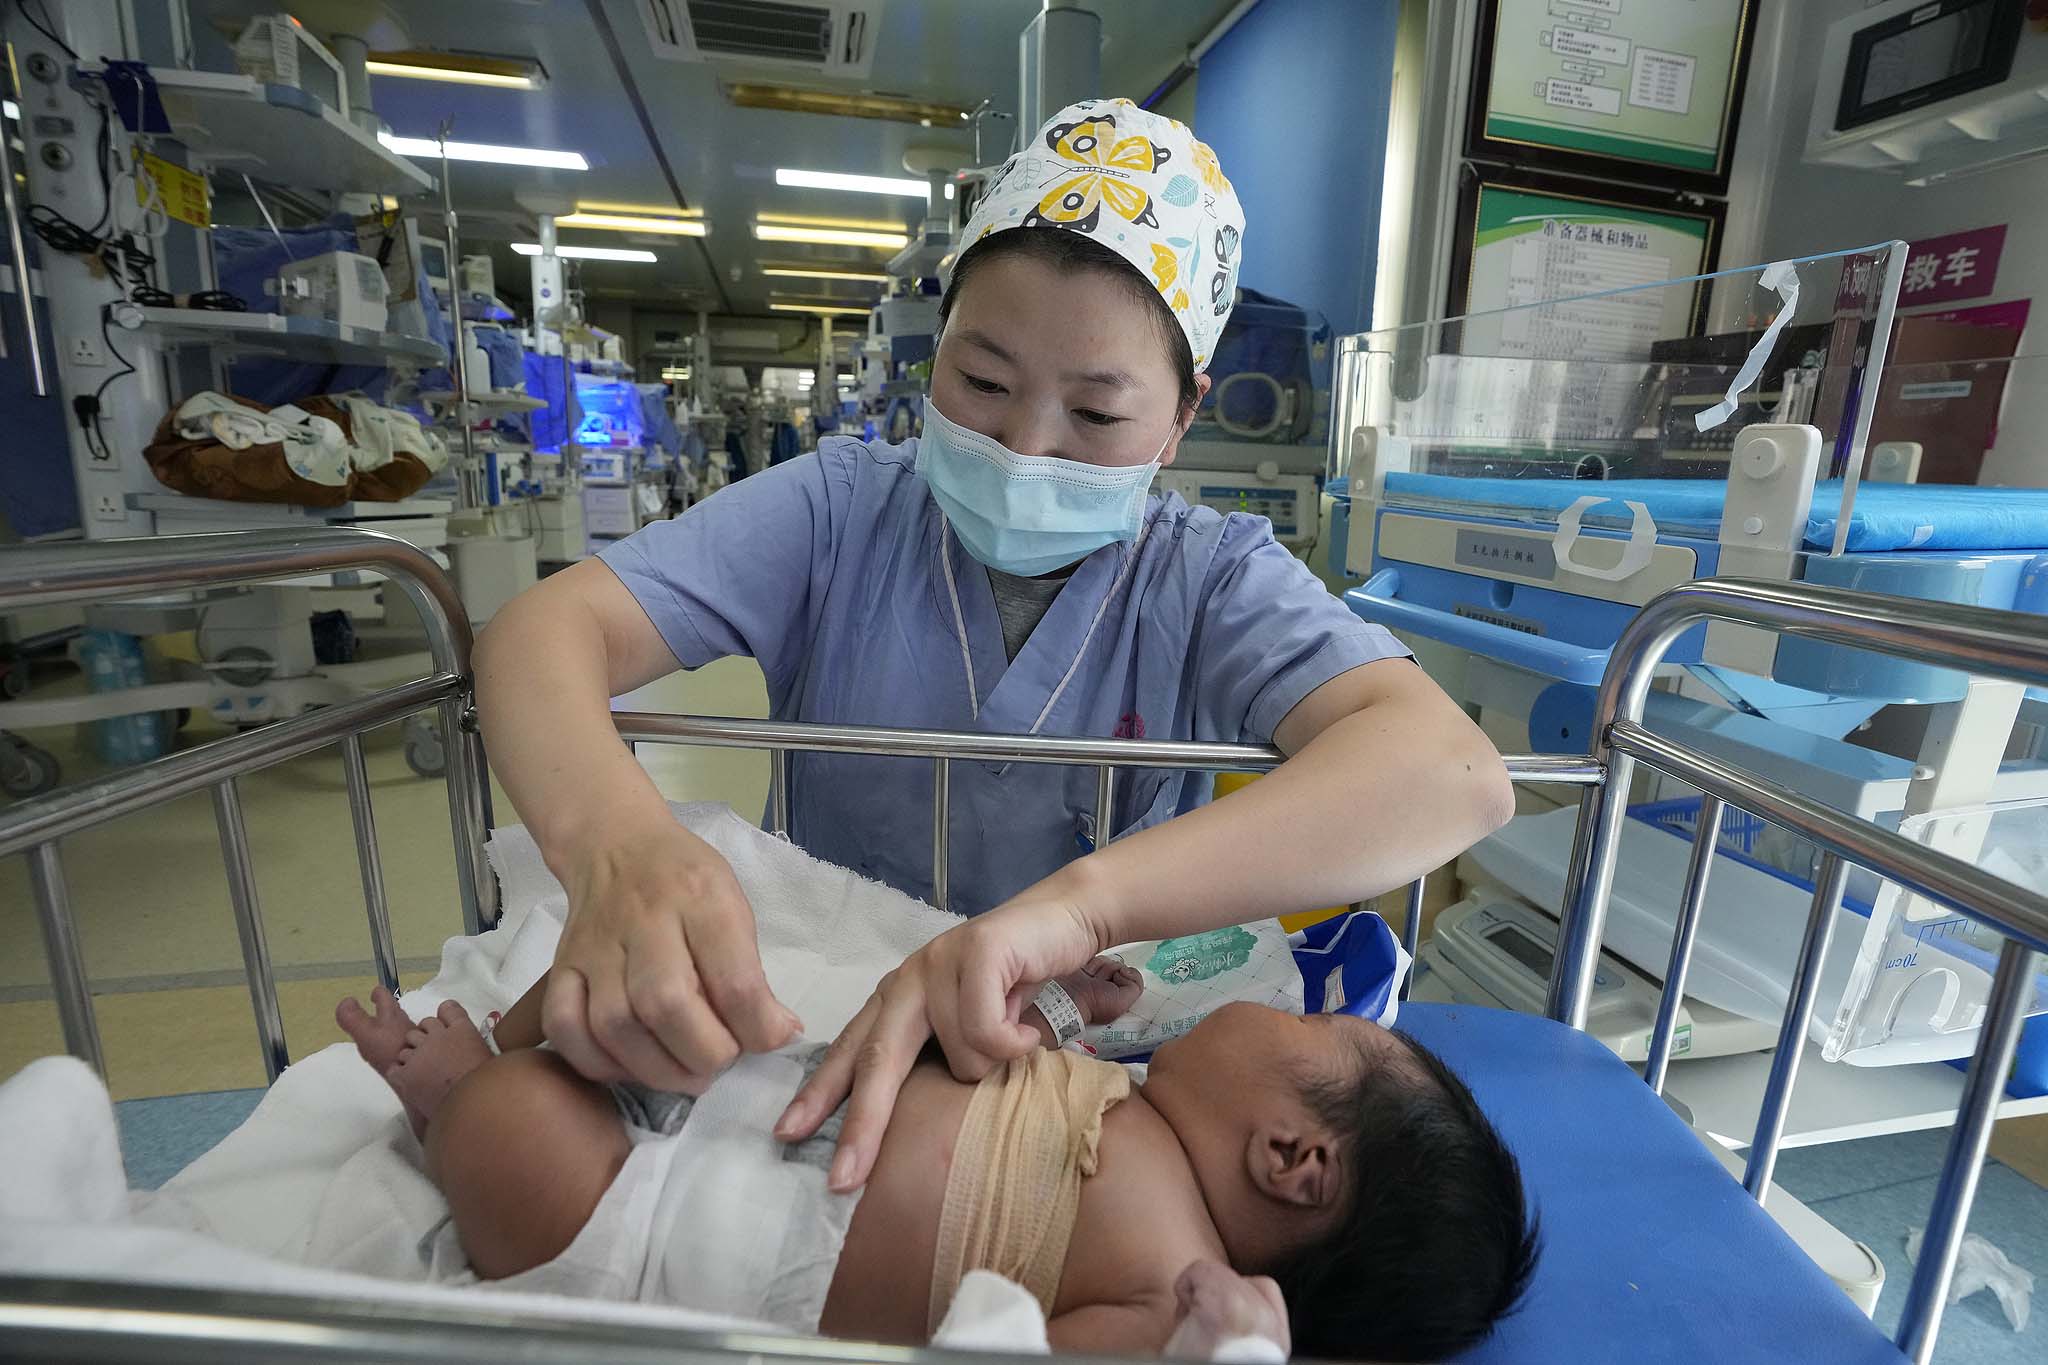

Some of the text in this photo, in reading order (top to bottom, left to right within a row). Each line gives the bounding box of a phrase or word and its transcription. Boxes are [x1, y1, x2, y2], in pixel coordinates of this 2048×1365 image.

[1542, 219, 1649, 249] 准备器械和物品
